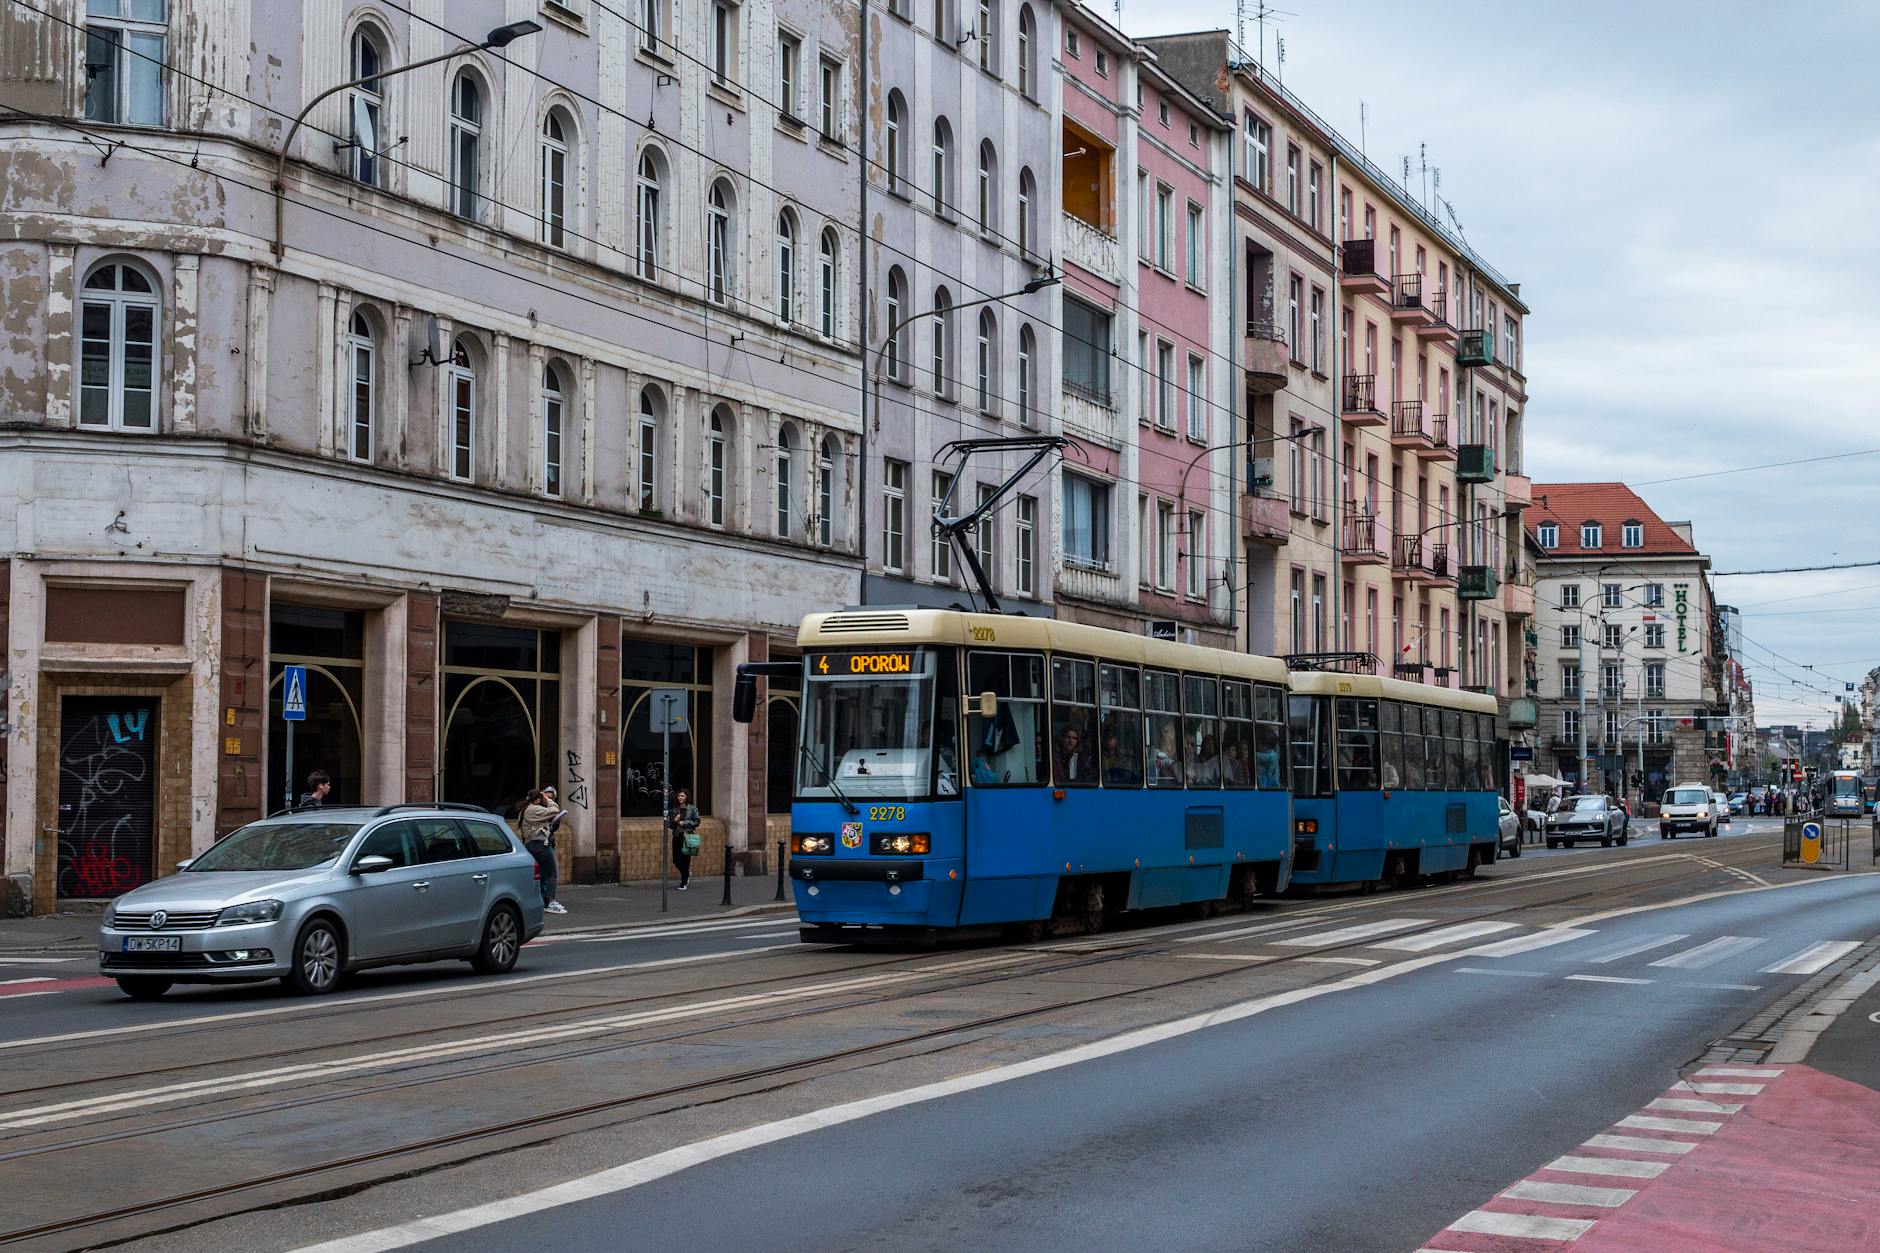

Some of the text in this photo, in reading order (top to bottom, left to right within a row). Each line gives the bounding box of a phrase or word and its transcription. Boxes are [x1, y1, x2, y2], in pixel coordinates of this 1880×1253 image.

[1675, 590, 1688, 652] HOTEL
[819, 653, 910, 674] 4 OPORÓW
[868, 805, 906, 821] 2278
[145, 938, 178, 950] 5KP14
